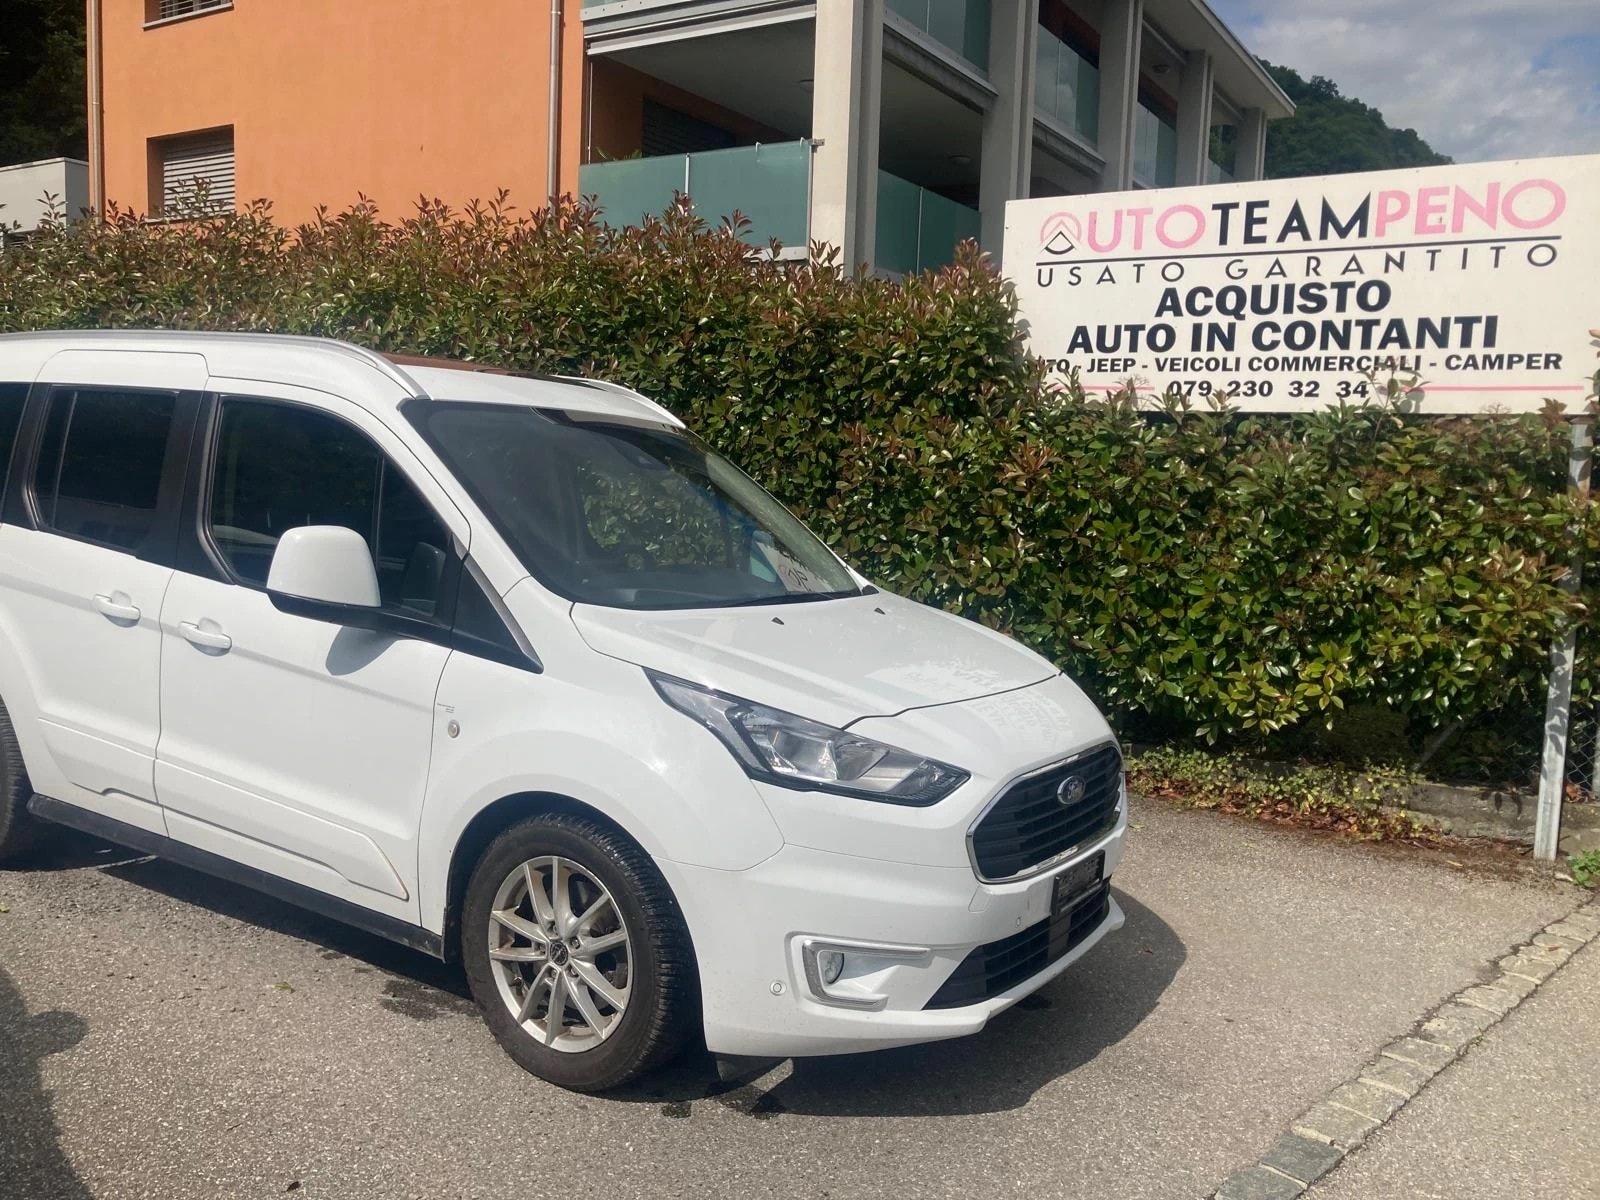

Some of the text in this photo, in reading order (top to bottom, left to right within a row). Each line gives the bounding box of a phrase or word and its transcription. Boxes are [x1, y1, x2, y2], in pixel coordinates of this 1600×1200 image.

[1037, 243, 1558, 287] USATO GARANTITO
[1154, 279, 1392, 321] ACQUISTO
[1066, 315, 1498, 354] AUTO IN CONTANTI
[1087, 358, 1136, 373] JEEP
[1155, 357, 1241, 372] VEICOLI
[1248, 354, 1421, 372] COMMERCIALI
[1445, 353, 1562, 370] CAMPER
[1167, 380, 1369, 398] 079 230 32 34
